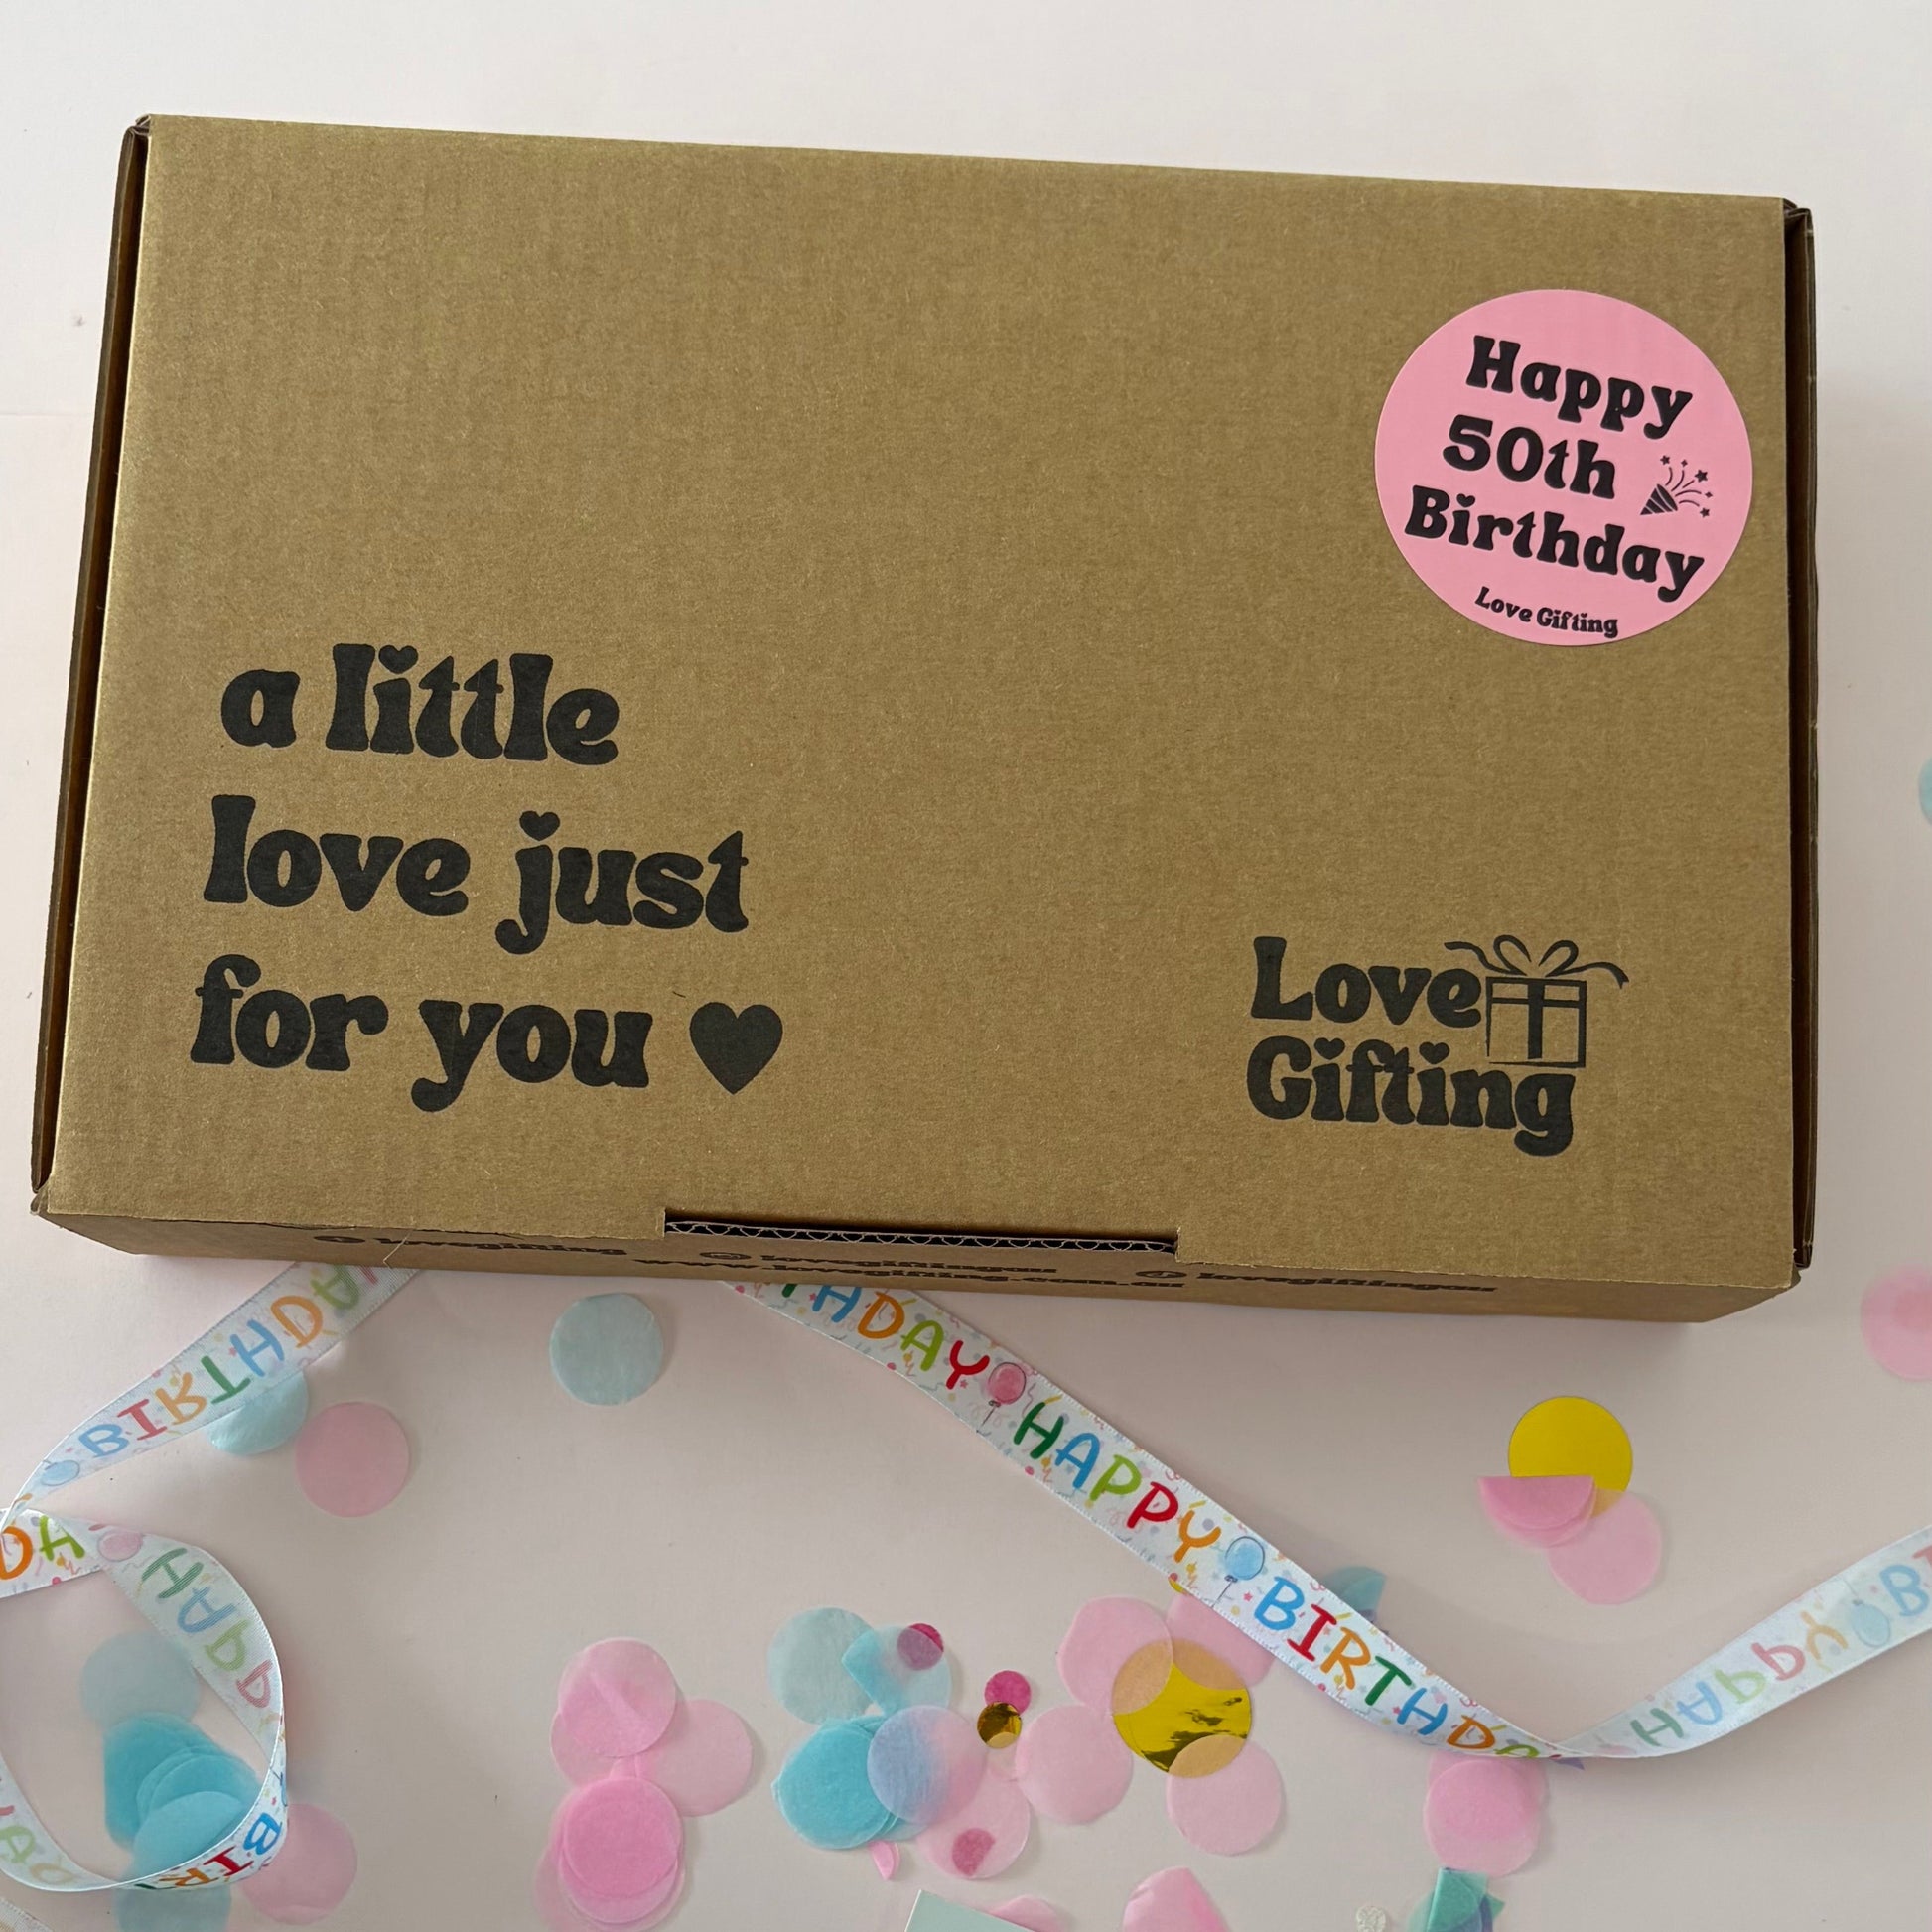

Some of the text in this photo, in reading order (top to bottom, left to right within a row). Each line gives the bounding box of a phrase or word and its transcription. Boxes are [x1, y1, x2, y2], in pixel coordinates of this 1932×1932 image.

[1466, 335, 1693, 440] Happy
[1443, 414, 1615, 499] 50th
[1404, 484, 1705, 603] Birthday
[1475, 586, 1619, 639] Love Gifting
[221, 643, 620, 765] a little
[204, 794, 749, 955] love just
[191, 954, 653, 1112] for you
[1250, 936, 1482, 1029] Love
[1246, 1035, 1577, 1157] Gifting
[1012, 1401, 1222, 1564] HAPPY
